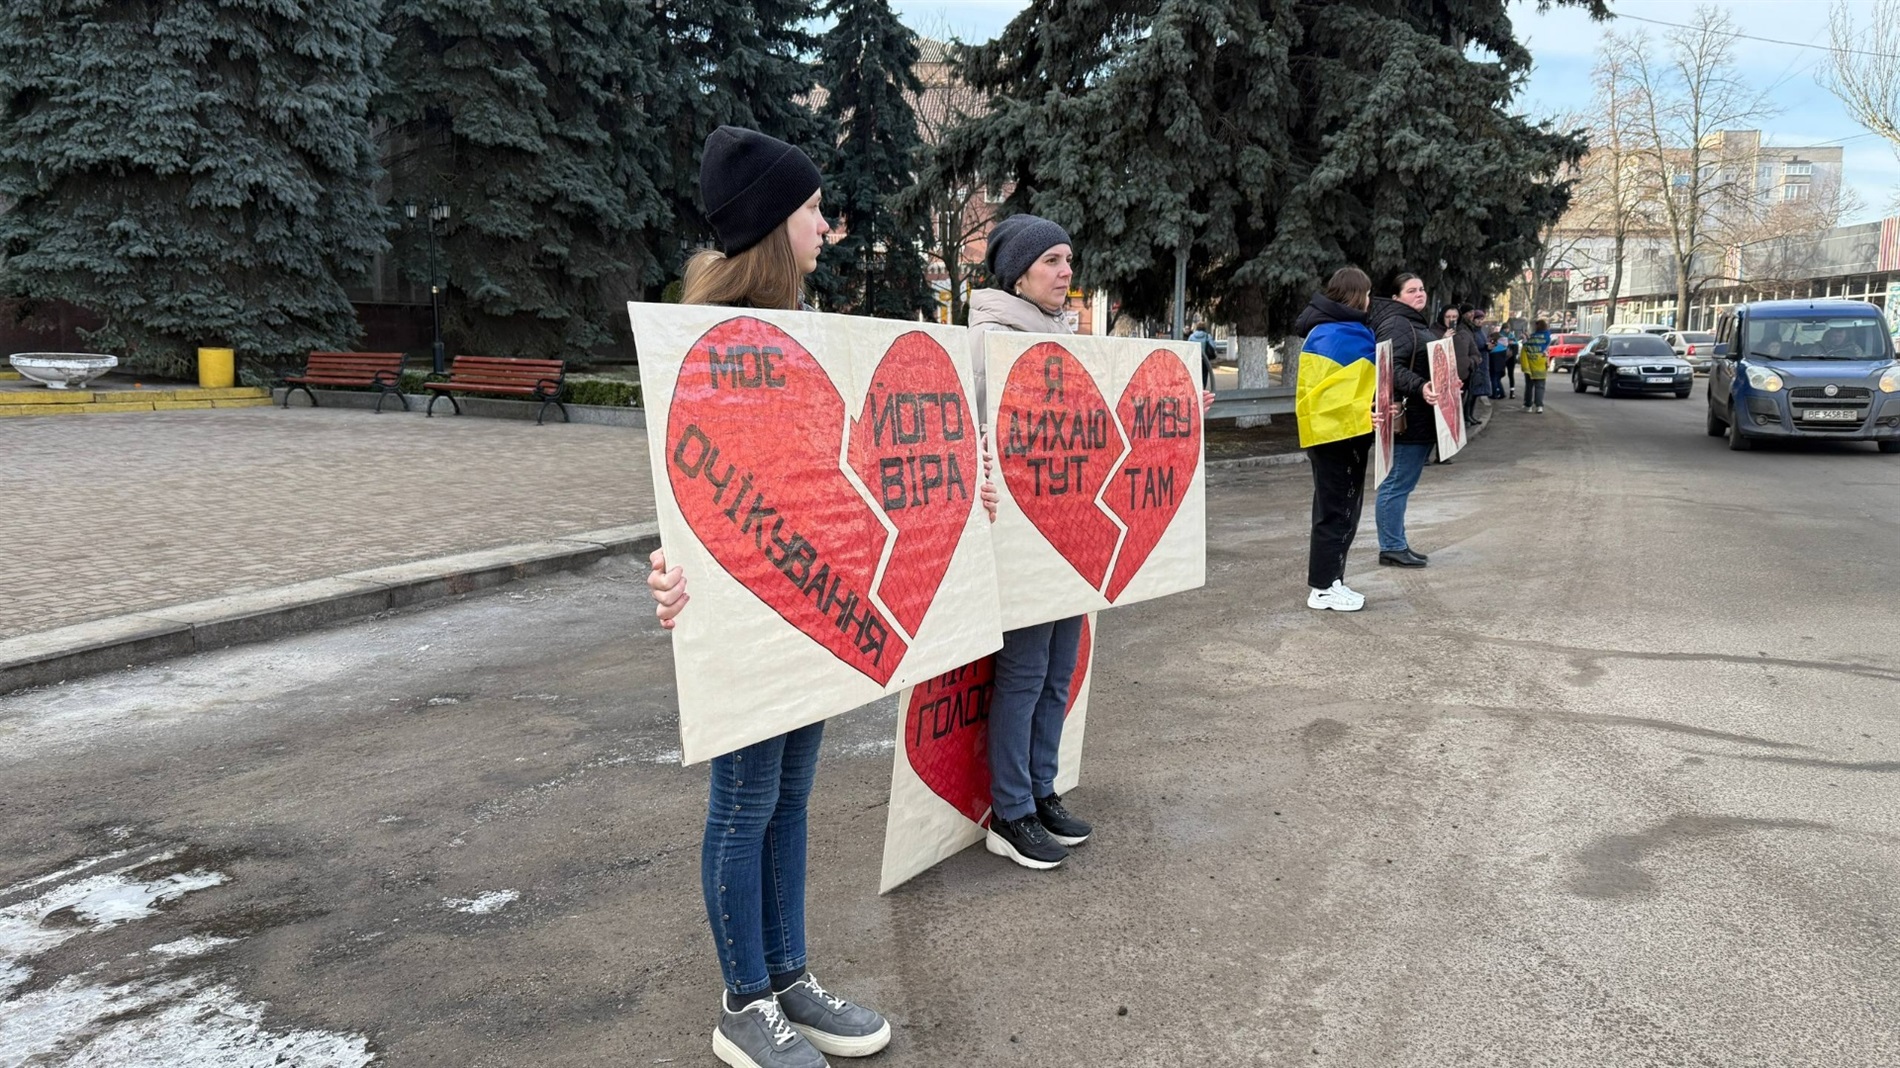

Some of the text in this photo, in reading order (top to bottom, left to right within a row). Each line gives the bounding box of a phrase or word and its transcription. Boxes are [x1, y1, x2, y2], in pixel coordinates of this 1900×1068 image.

[708, 344, 786, 389] МОЄ
[1044, 355, 1063, 403] Я
[870, 382, 963, 447] ЙОГО
[1004, 408, 1107, 458] ДИХАЮ
[1131, 396, 1191, 438] ЖИВУ
[880, 448, 967, 511] ВІРА
[1027, 455, 1089, 496] ТУТ
[1124, 466, 1174, 510] ТАМ
[673, 424, 888, 667] ОЧІКУВАННЯ
